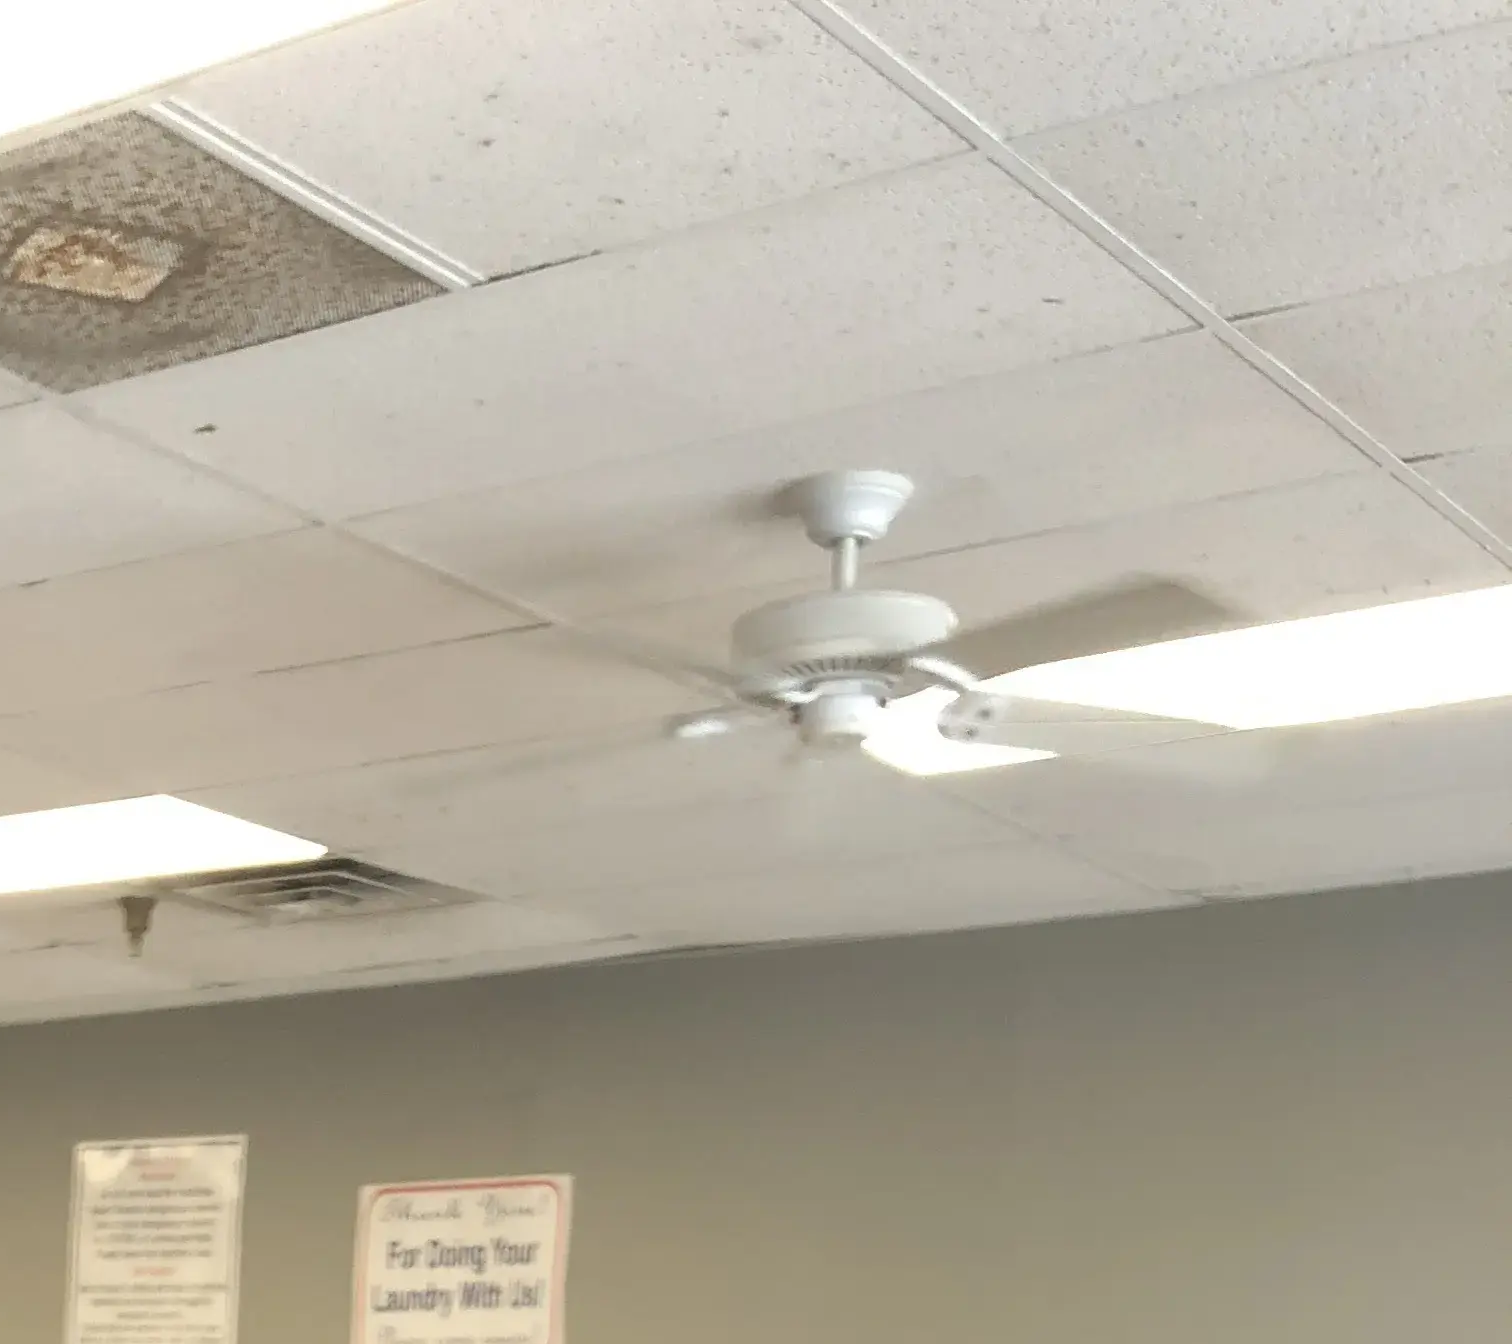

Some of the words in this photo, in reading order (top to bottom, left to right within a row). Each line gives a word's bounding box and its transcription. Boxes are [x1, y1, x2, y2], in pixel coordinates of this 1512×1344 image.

[386, 1240, 422, 1270] For
[426, 1238, 486, 1275] Doing
[491, 1237, 540, 1266] Your
[370, 1283, 456, 1319] Laundry
[457, 1281, 503, 1311] With
